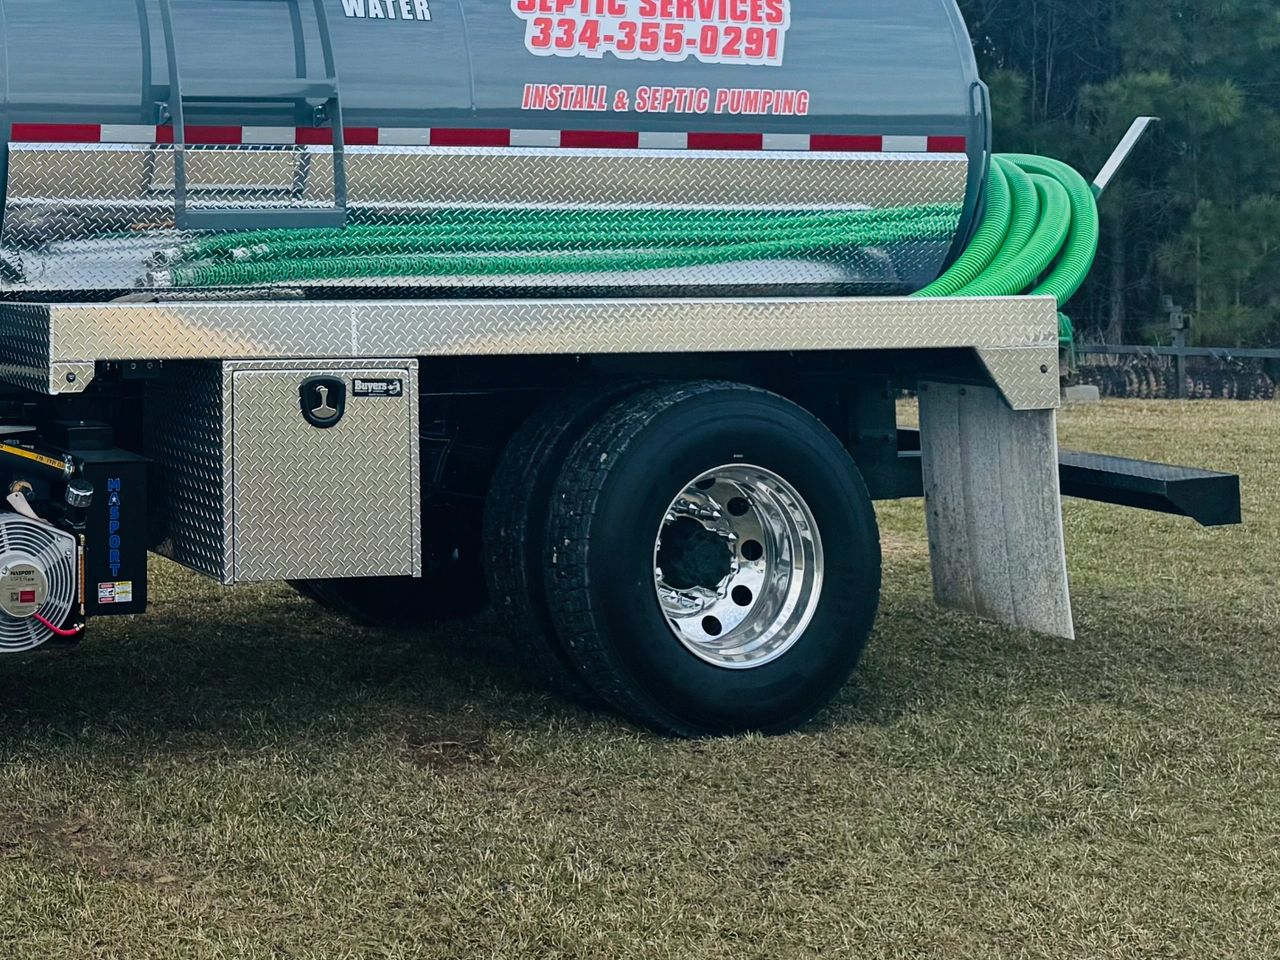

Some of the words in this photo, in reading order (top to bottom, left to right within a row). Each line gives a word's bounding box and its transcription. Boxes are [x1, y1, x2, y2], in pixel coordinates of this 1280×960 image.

[530, 16, 780, 58] 334-355-0291
[521, 83, 607, 112] INSTALL
[613, 89, 628, 112] &
[635, 86, 710, 114] SEPTIC
[715, 88, 811, 116] PUMPING
[354, 379, 388, 393] Buyers
[107, 478, 121, 577] MASPORT
